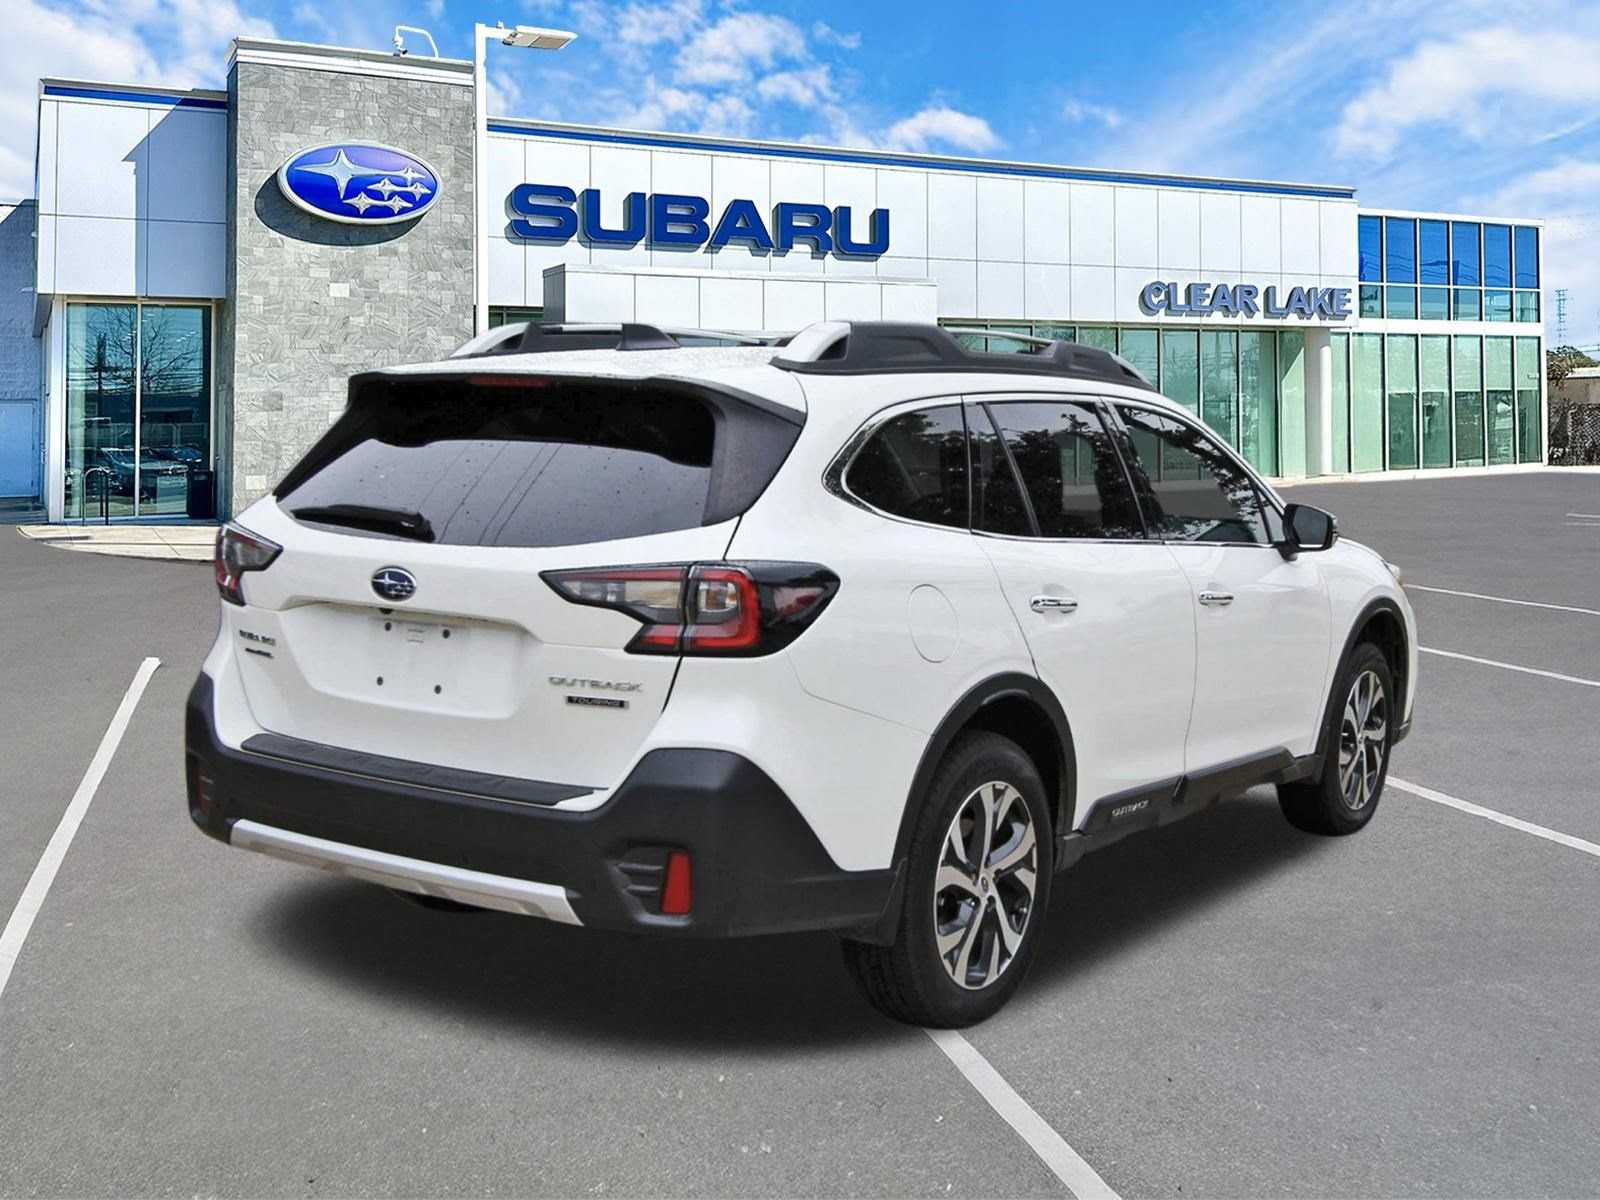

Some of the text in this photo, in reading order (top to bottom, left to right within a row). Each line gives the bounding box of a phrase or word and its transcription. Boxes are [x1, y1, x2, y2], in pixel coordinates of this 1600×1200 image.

[507, 183, 889, 259] SUBARU
[1140, 280, 1352, 320] CLEAR LAKE
[549, 676, 643, 693] OUTBACK
[571, 696, 622, 708] TOURING
